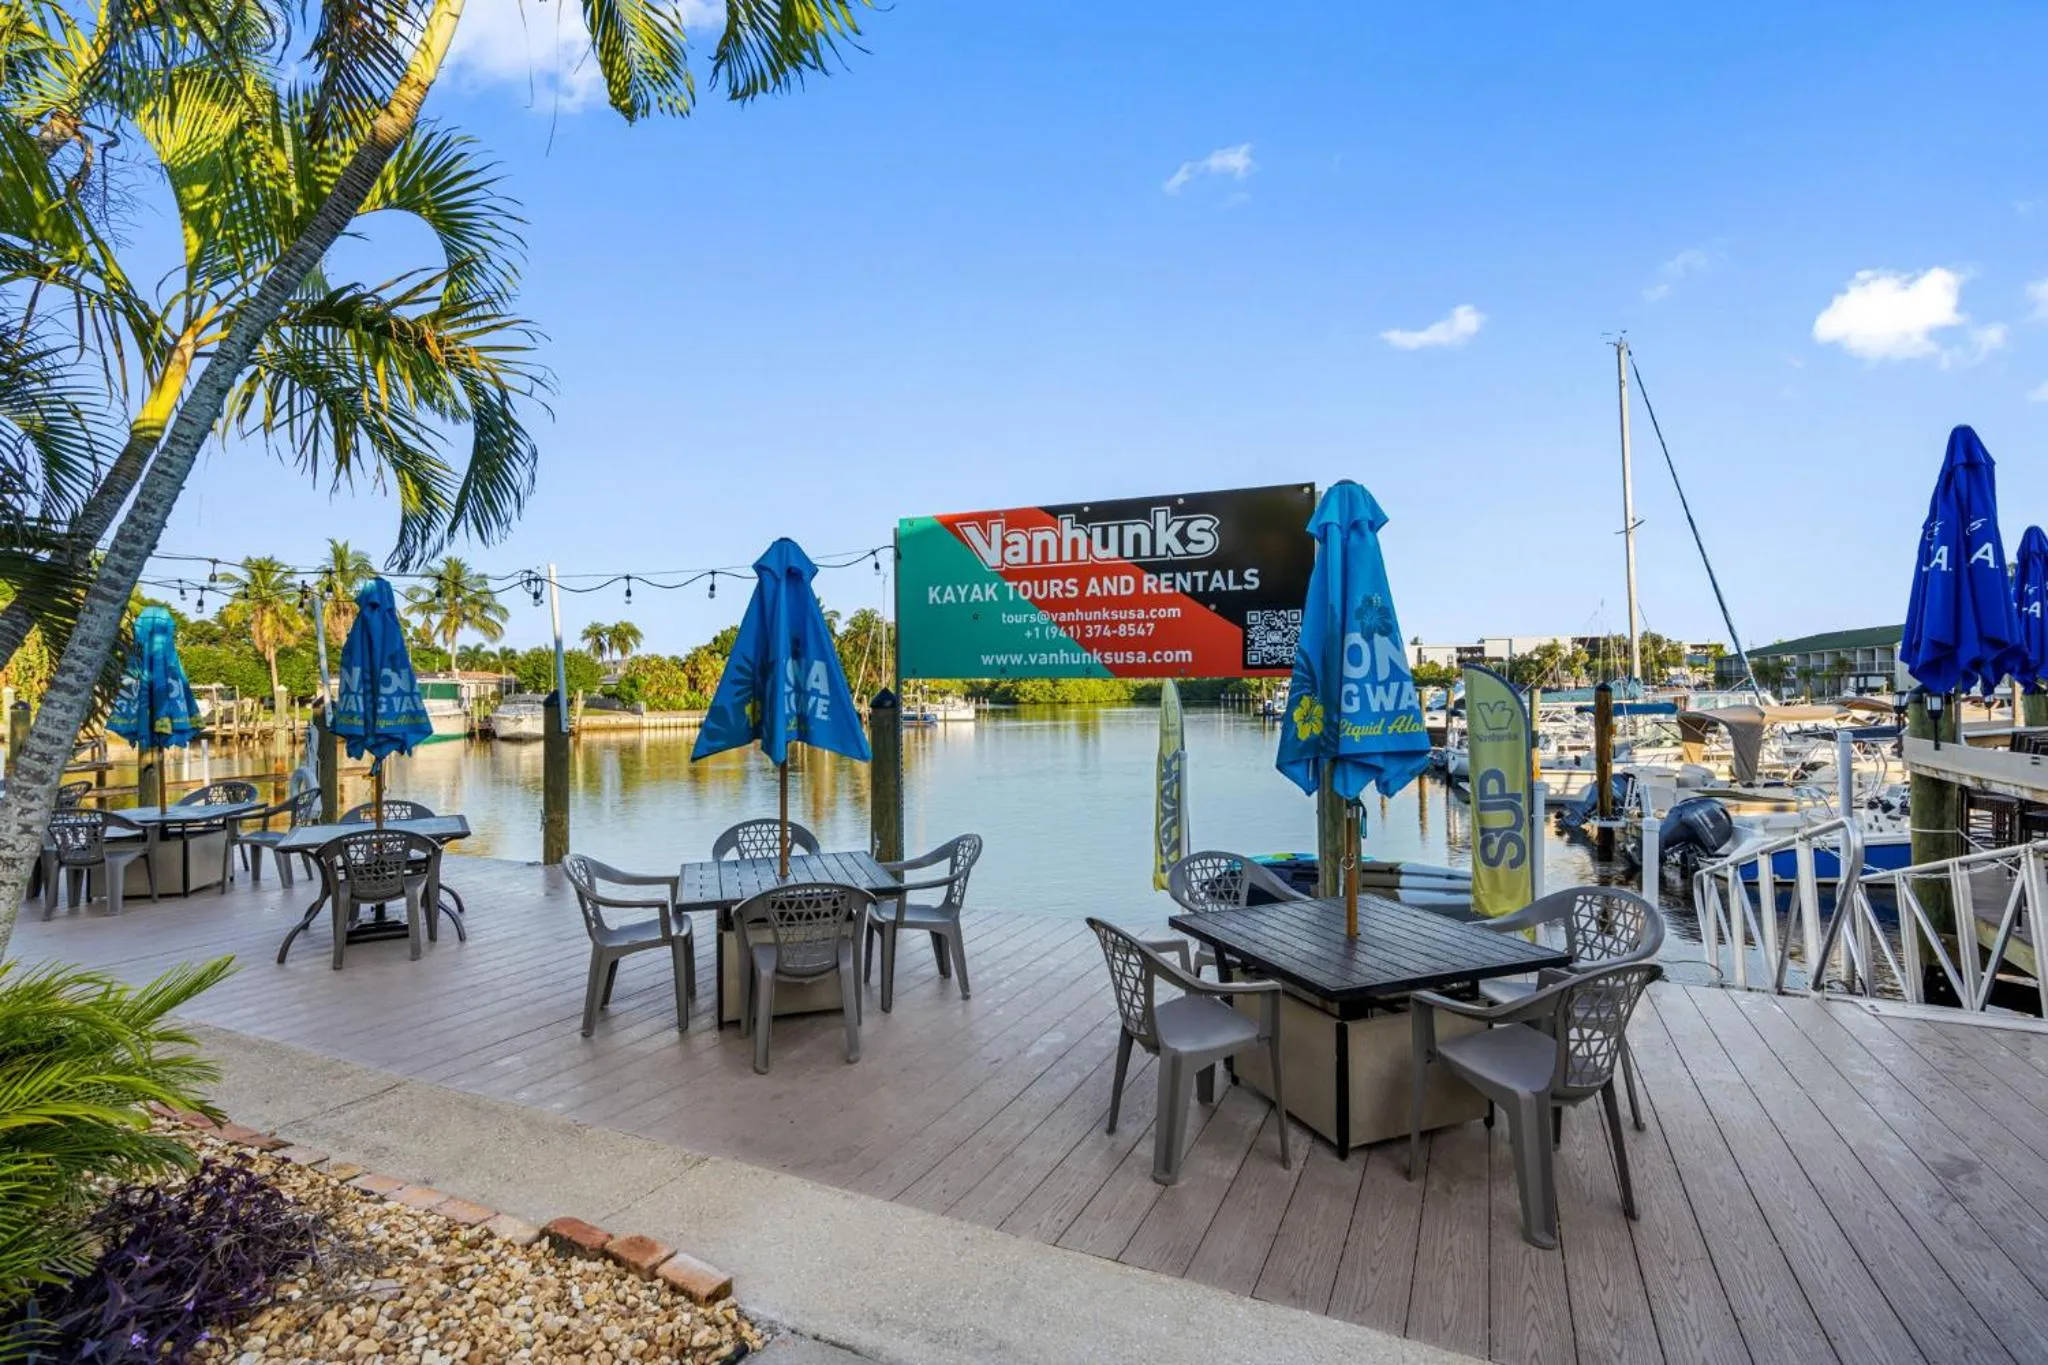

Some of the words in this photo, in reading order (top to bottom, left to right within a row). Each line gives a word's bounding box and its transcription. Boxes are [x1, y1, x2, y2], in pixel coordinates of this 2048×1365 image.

[956, 507, 1219, 570] Vanhunks
[928, 582, 999, 605] KAYAK
[1005, 578, 1078, 601] TOURS
[1085, 575, 1135, 597] AND
[1143, 568, 1260, 594] RENTALS
[1002, 606, 1181, 624] tours@vanhunksusa.com
[1024, 627, 1039, 639] +1
[1045, 625, 1081, 640] (941)
[1085, 623, 1155, 638] 374-8547
[981, 648, 1192, 665] www.vanhunksusa.com
[1479, 768, 1527, 871] SUP
